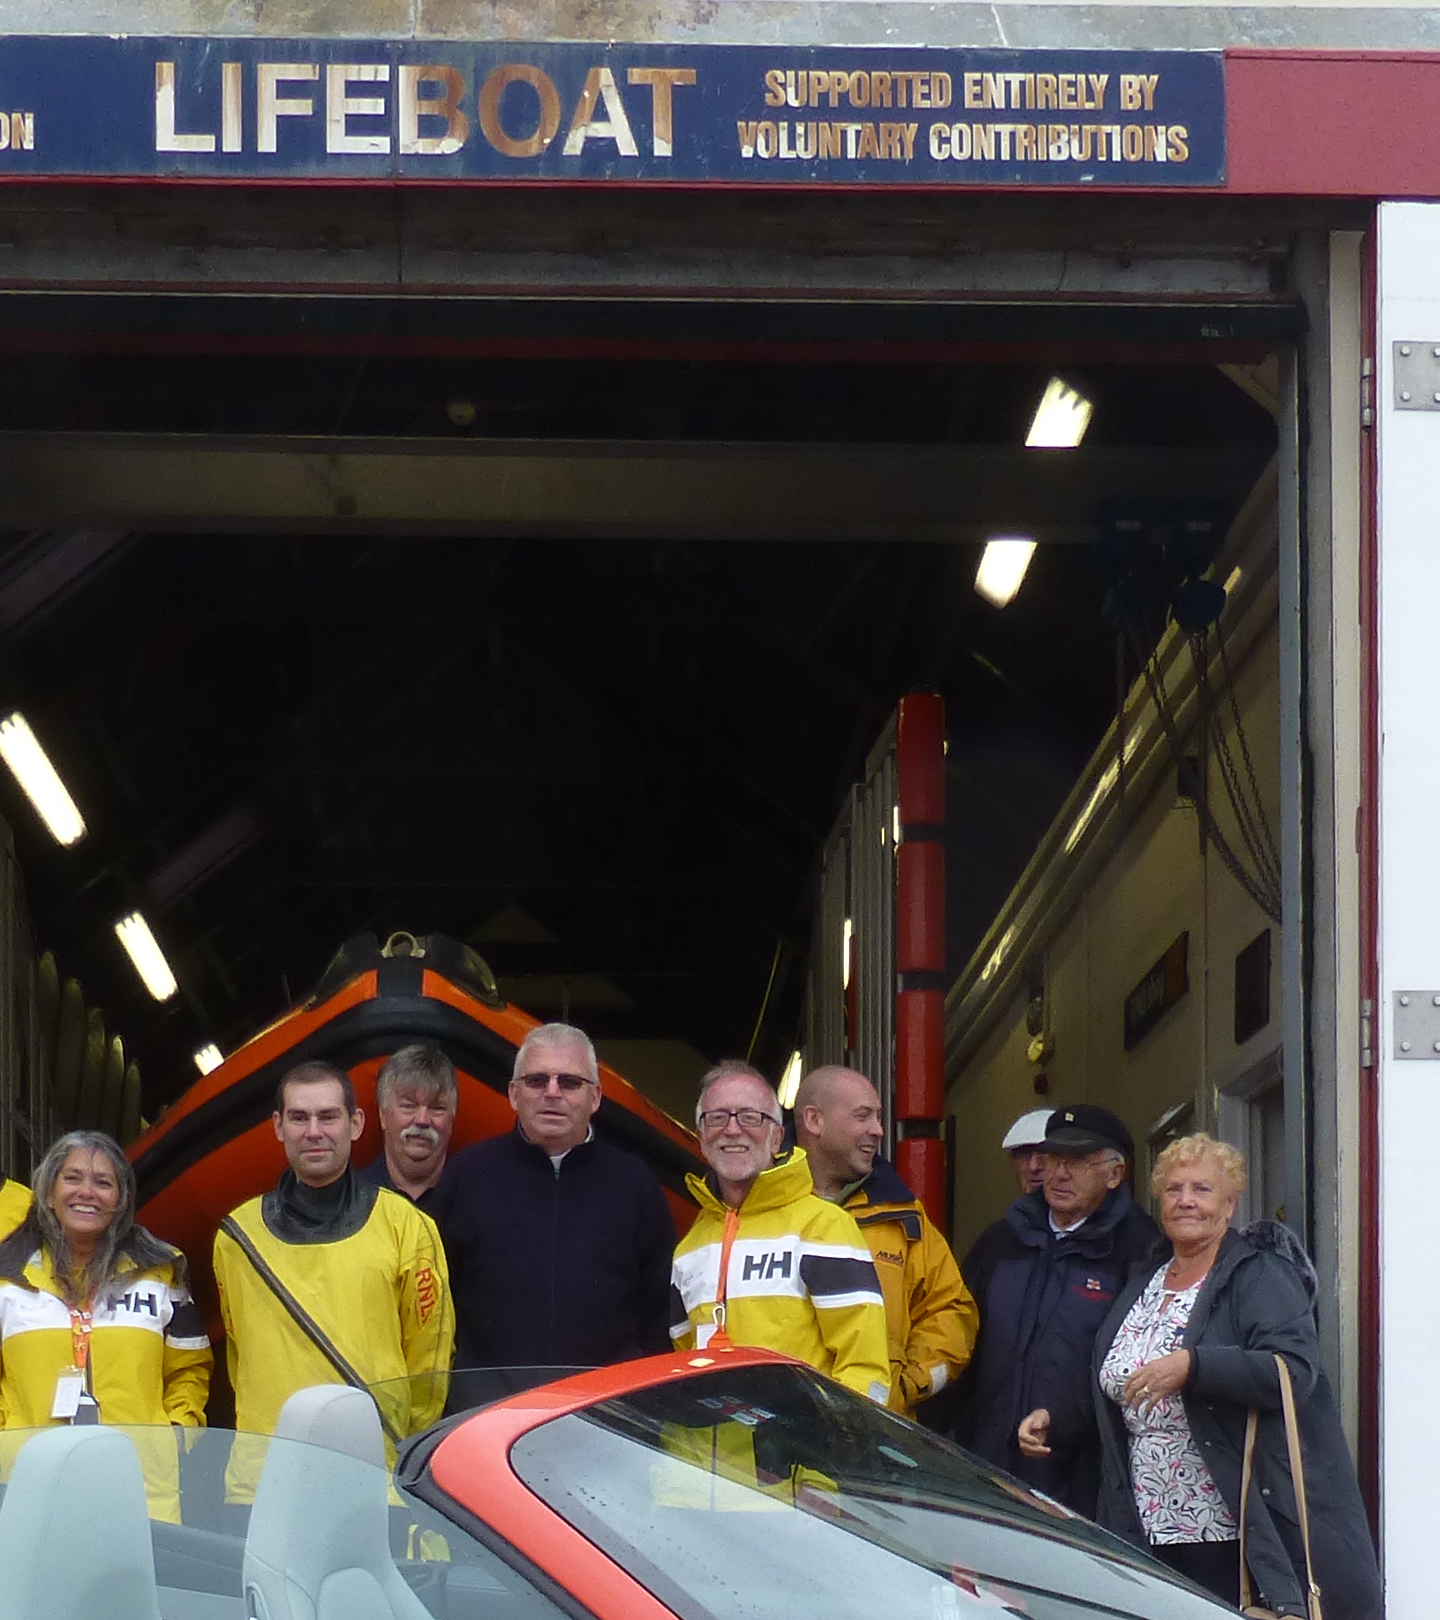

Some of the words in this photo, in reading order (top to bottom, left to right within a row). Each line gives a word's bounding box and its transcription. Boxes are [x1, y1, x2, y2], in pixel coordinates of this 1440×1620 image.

[155, 61, 697, 159] LIFEBOAT
[764, 70, 952, 110] SUPPORTED
[963, 72, 1109, 112] ENTIRELY
[1120, 74, 1159, 112] BY
[737, 120, 917, 163] VOLUNTARY
[928, 122, 1190, 164] CONTRIBUTIONS
[742, 1251, 792, 1282] HH
[109, 1291, 158, 1317] HH
